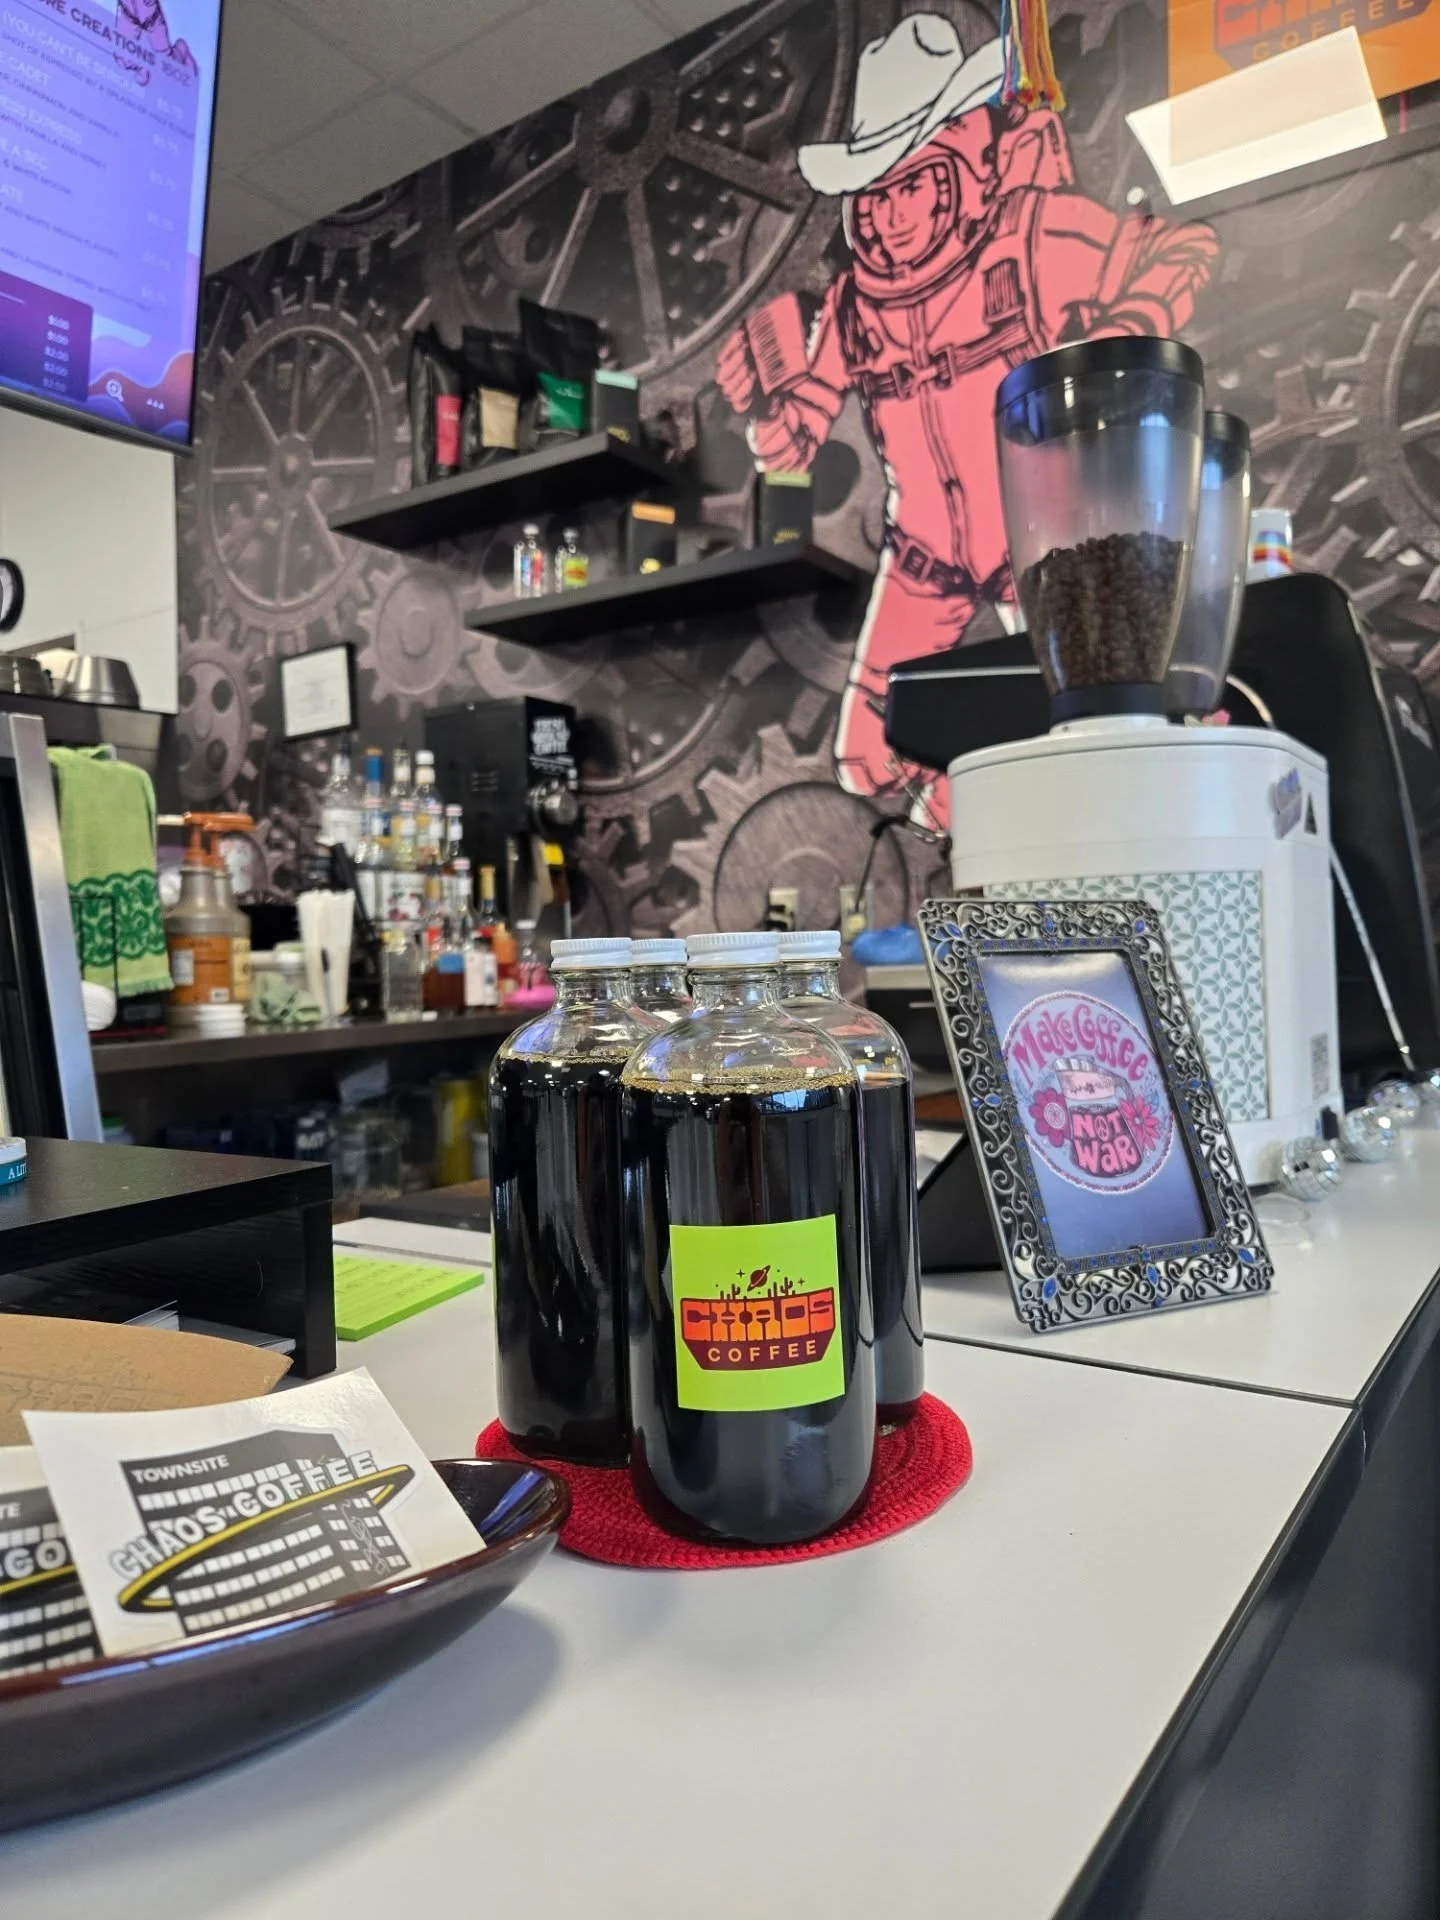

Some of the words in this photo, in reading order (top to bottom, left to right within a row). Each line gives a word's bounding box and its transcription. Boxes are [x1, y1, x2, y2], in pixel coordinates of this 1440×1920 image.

[71, 7, 156, 66] CREATIONS
[1072, 1110, 1124, 1142] NOT
[682, 1289, 834, 1342] CHAOS
[707, 1339, 817, 1363] COFFEE
[131, 1454, 231, 1485] TOWNSITE
[109, 1505, 228, 1582] CHAOS
[232, 1450, 380, 1519] COFFEE
